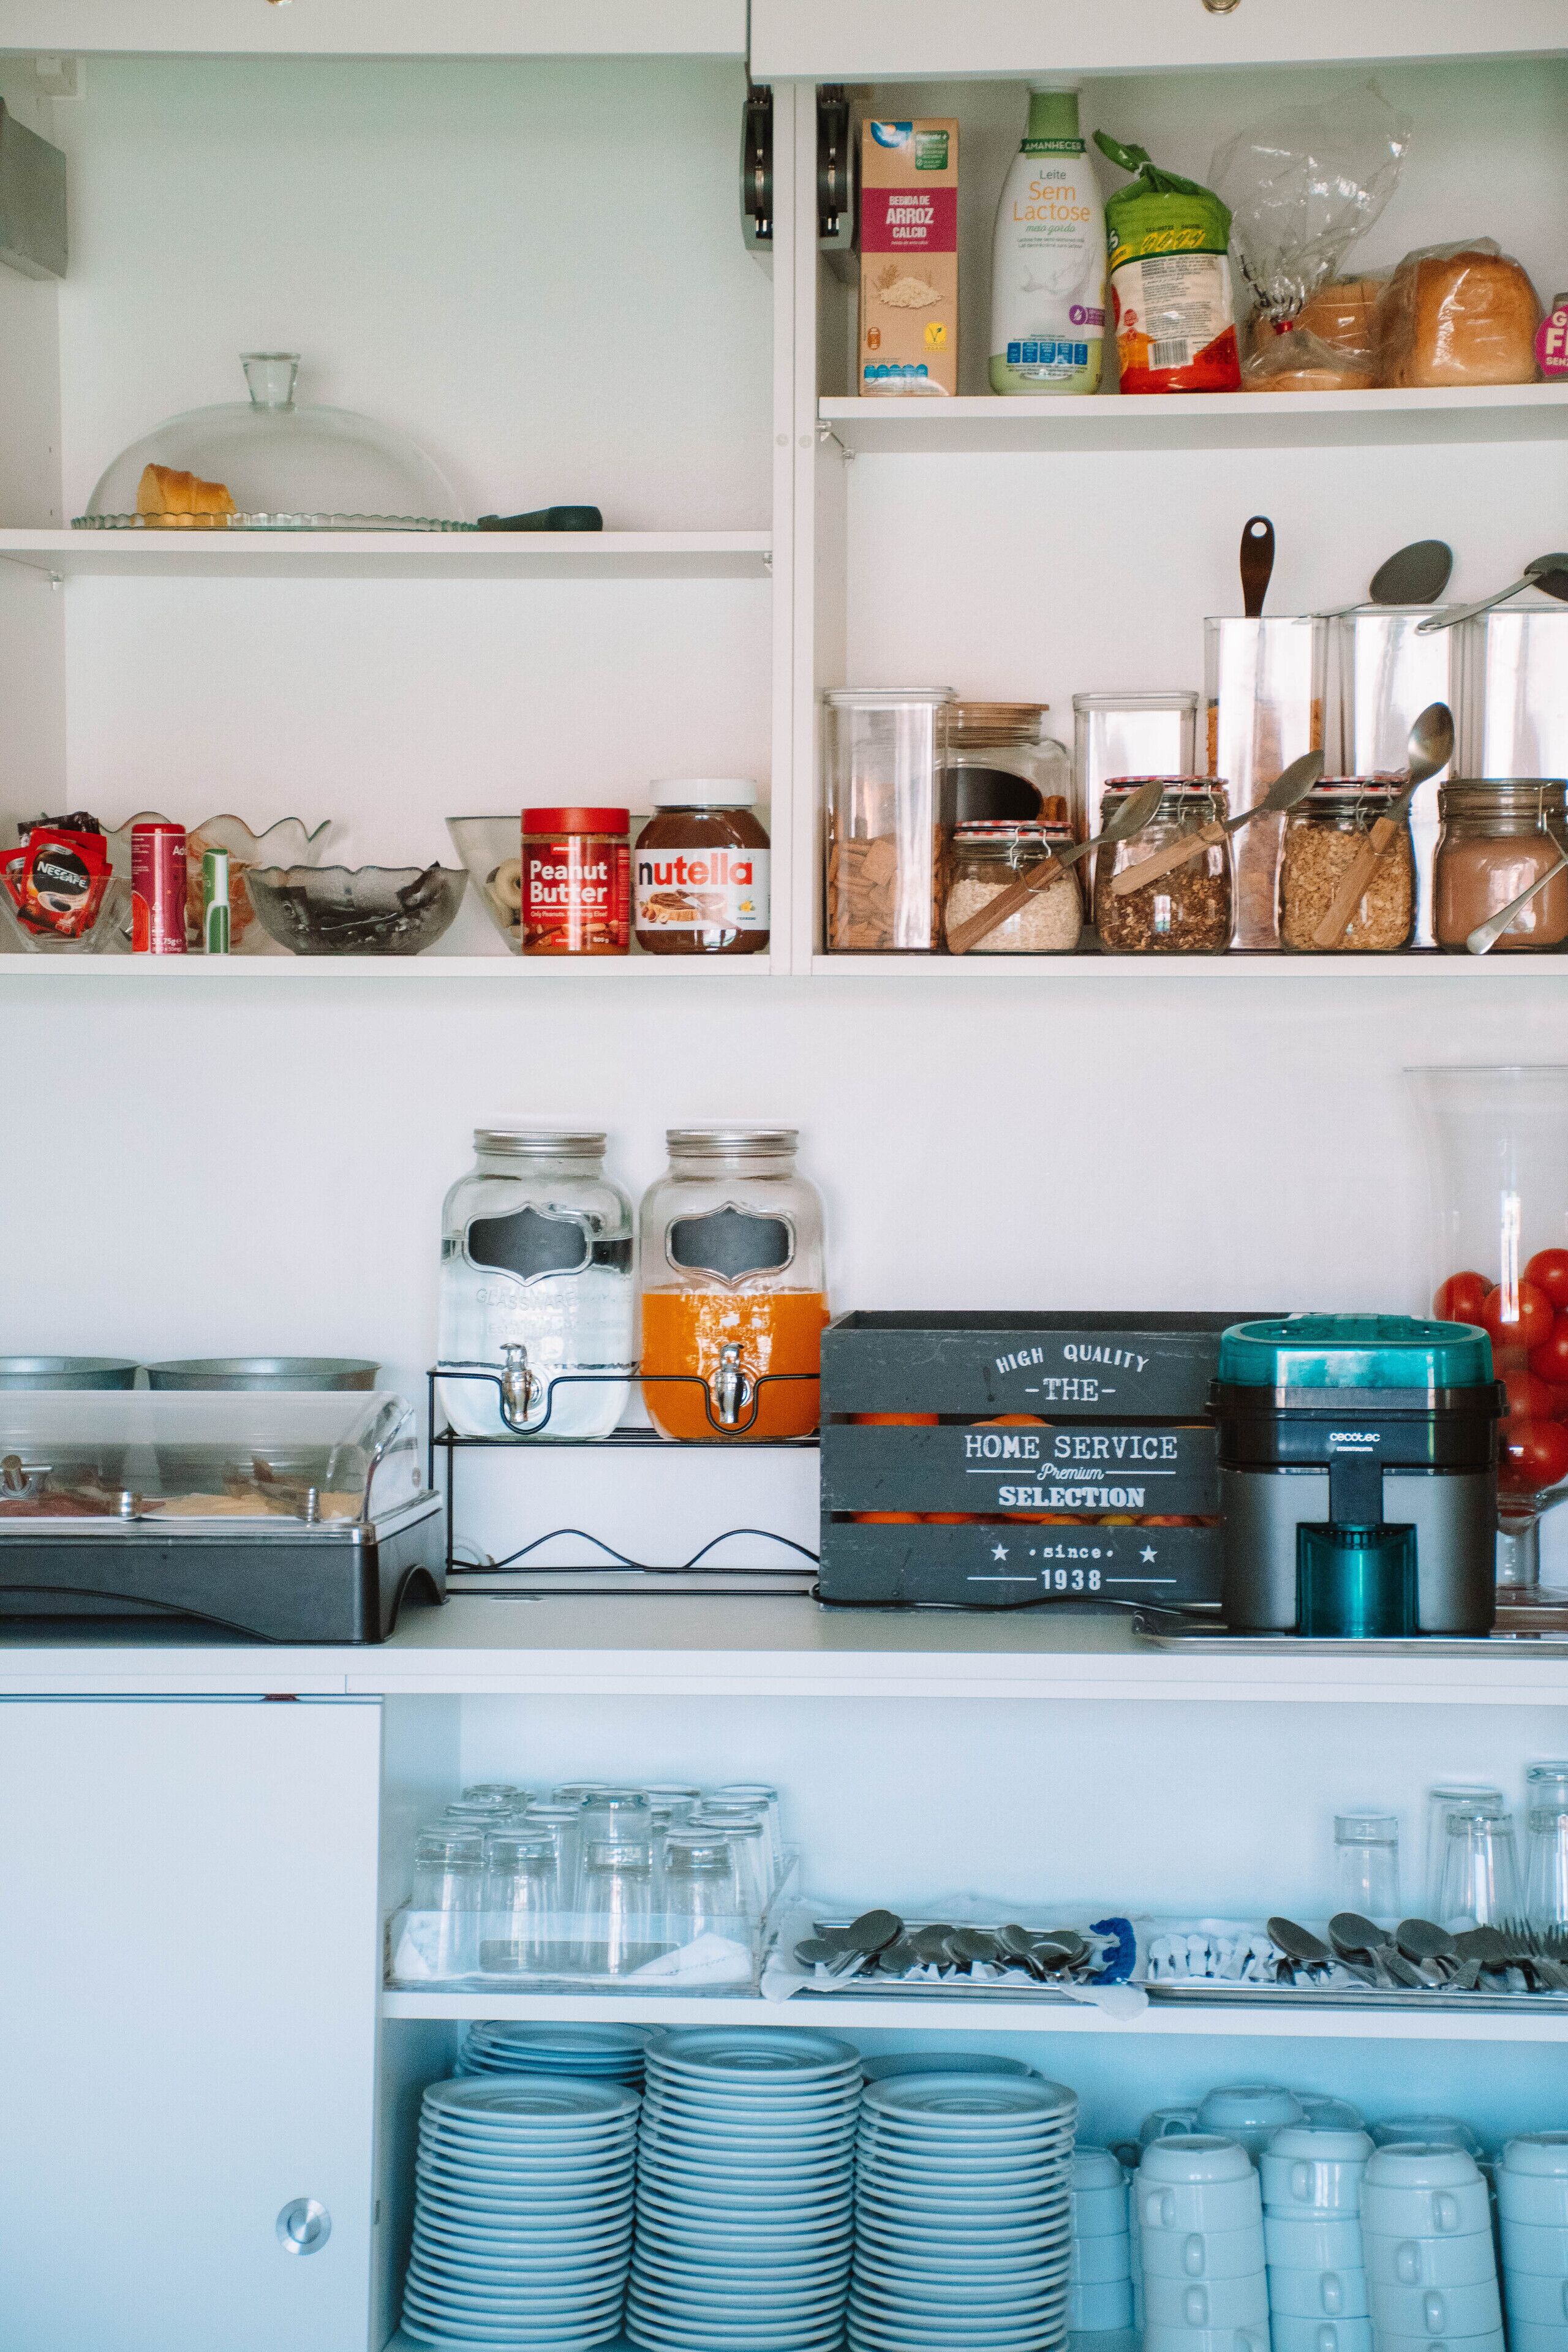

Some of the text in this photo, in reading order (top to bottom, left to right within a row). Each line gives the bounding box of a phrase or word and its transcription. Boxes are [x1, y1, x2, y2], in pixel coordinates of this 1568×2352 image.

[1039, 170, 1067, 179] Leite
[919, 195, 930, 205] DE
[1029, 181, 1076, 201] Sem
[886, 208, 934, 224] ARROZ
[1013, 201, 1090, 222] Lactose
[530, 860, 608, 880] Peanut
[639, 853, 752, 886] nutella
[530, 881, 608, 903] Butter
[995, 1344, 1149, 1374] HIGH QUALITY
[965, 1435, 1178, 1460] HOME SERVICE
[1037, 1463, 1105, 1480] Premium
[998, 1486, 1145, 1507] SELECTION
[1043, 1544, 1101, 1559] since
[1041, 1569, 1101, 1591] 1938
